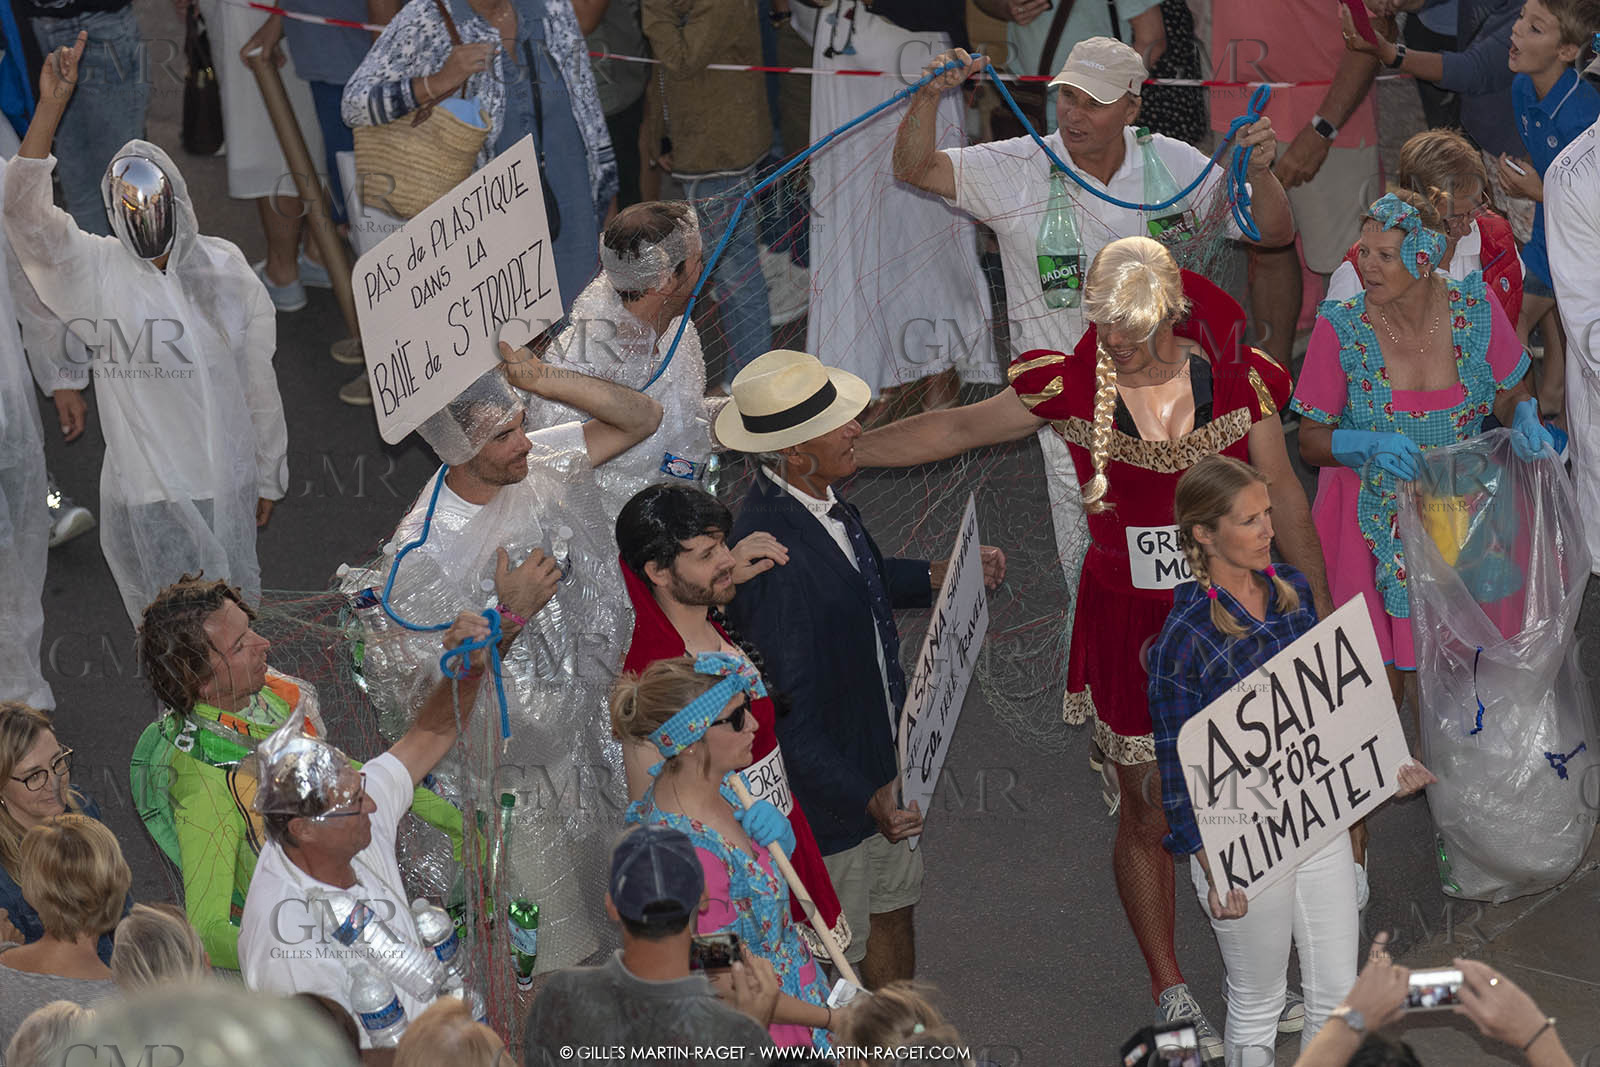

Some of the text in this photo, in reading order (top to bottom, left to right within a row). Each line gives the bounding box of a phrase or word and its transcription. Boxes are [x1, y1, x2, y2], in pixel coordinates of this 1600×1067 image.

[364, 254, 401, 310] PAS
[407, 237, 427, 271] de
[411, 237, 488, 309] DANS LA
[425, 340, 442, 380] de
[471, 239, 552, 337] TROPEZ
[1207, 626, 1372, 807] ASANA
[1269, 733, 1329, 798] FÖR
